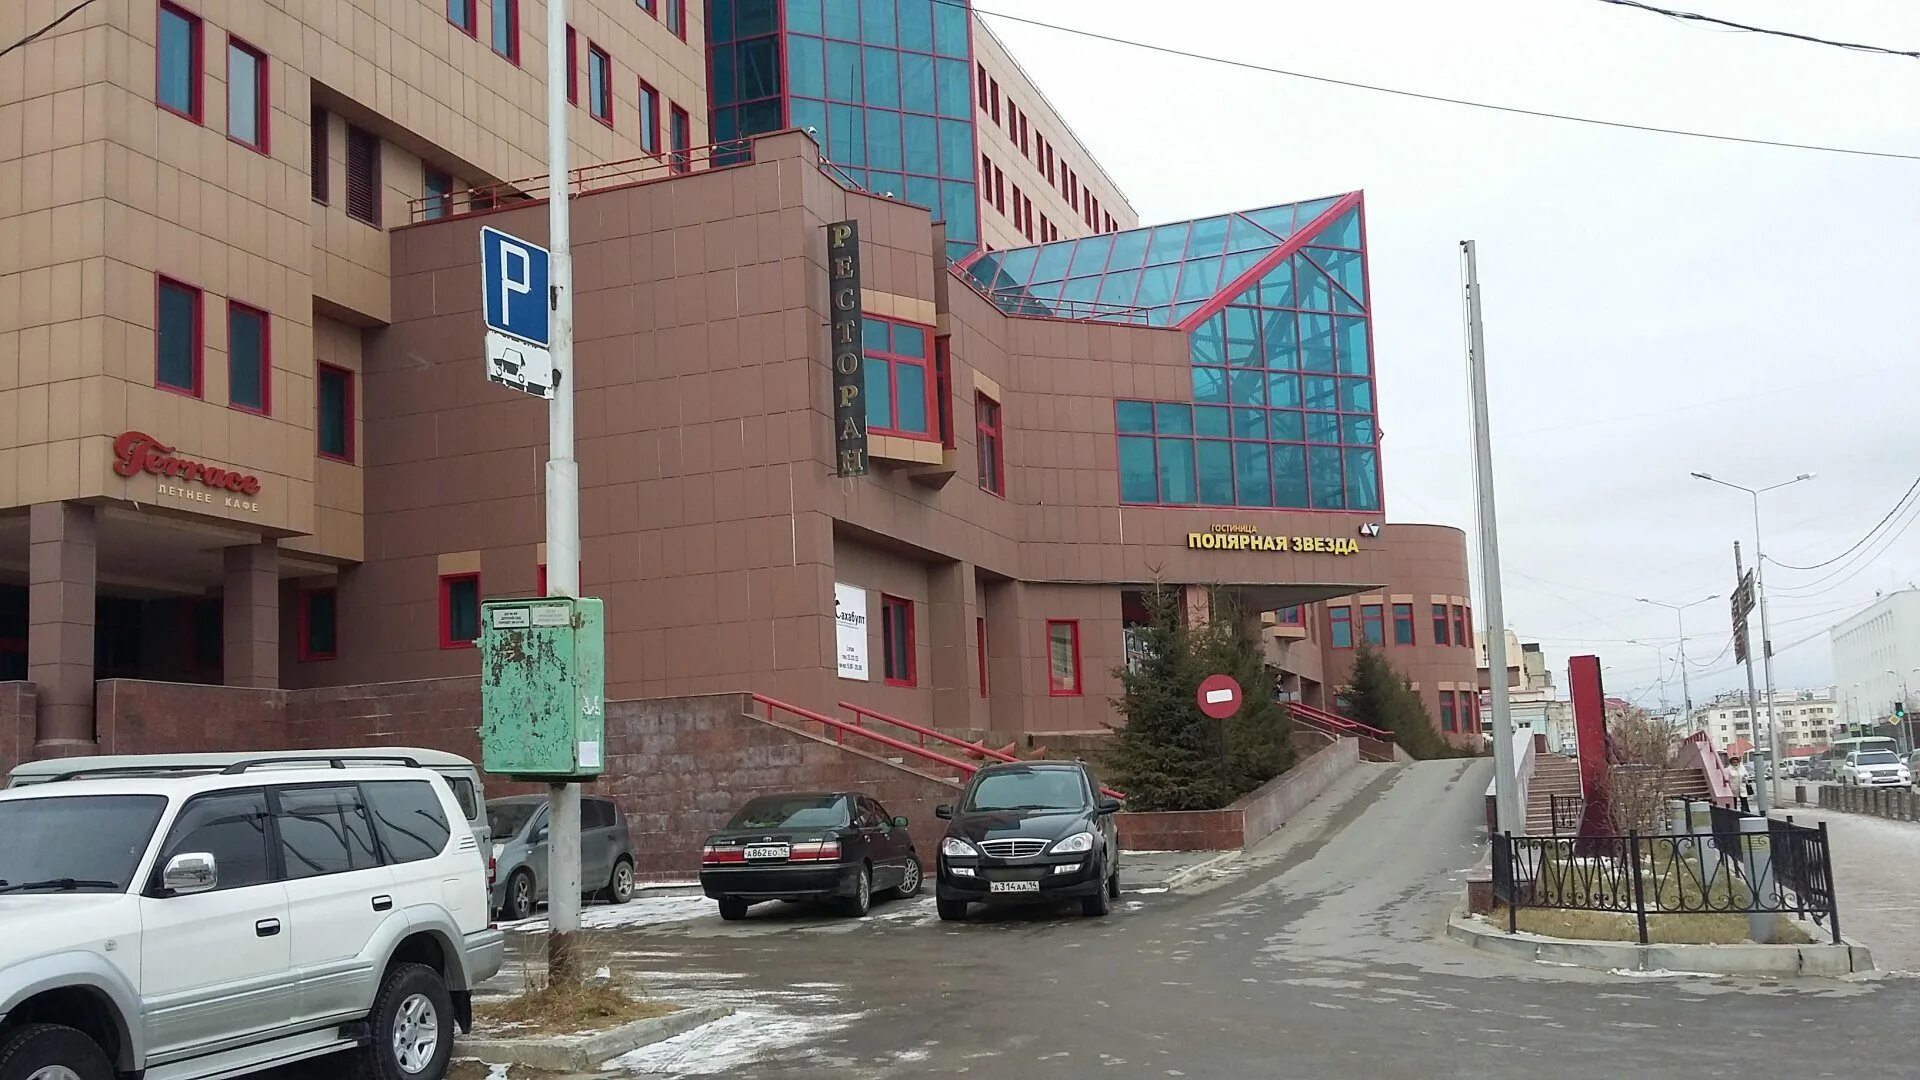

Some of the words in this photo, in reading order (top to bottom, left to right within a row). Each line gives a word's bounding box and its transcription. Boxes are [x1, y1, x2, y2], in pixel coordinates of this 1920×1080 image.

[500, 239, 532, 326] P
[832, 225, 864, 471] РЕСТОРАН
[113, 431, 261, 496] Terrace
[158, 483, 212, 503] ЛЕТНЕЕ
[225, 496, 259, 512] КАФЕ
[1188, 532, 1287, 552] ПОЛЯРНАЯ
[1292, 537, 1359, 555] ЗВЕЗДА
[1211, 523, 1257, 534] ГОСТИНИЦА
